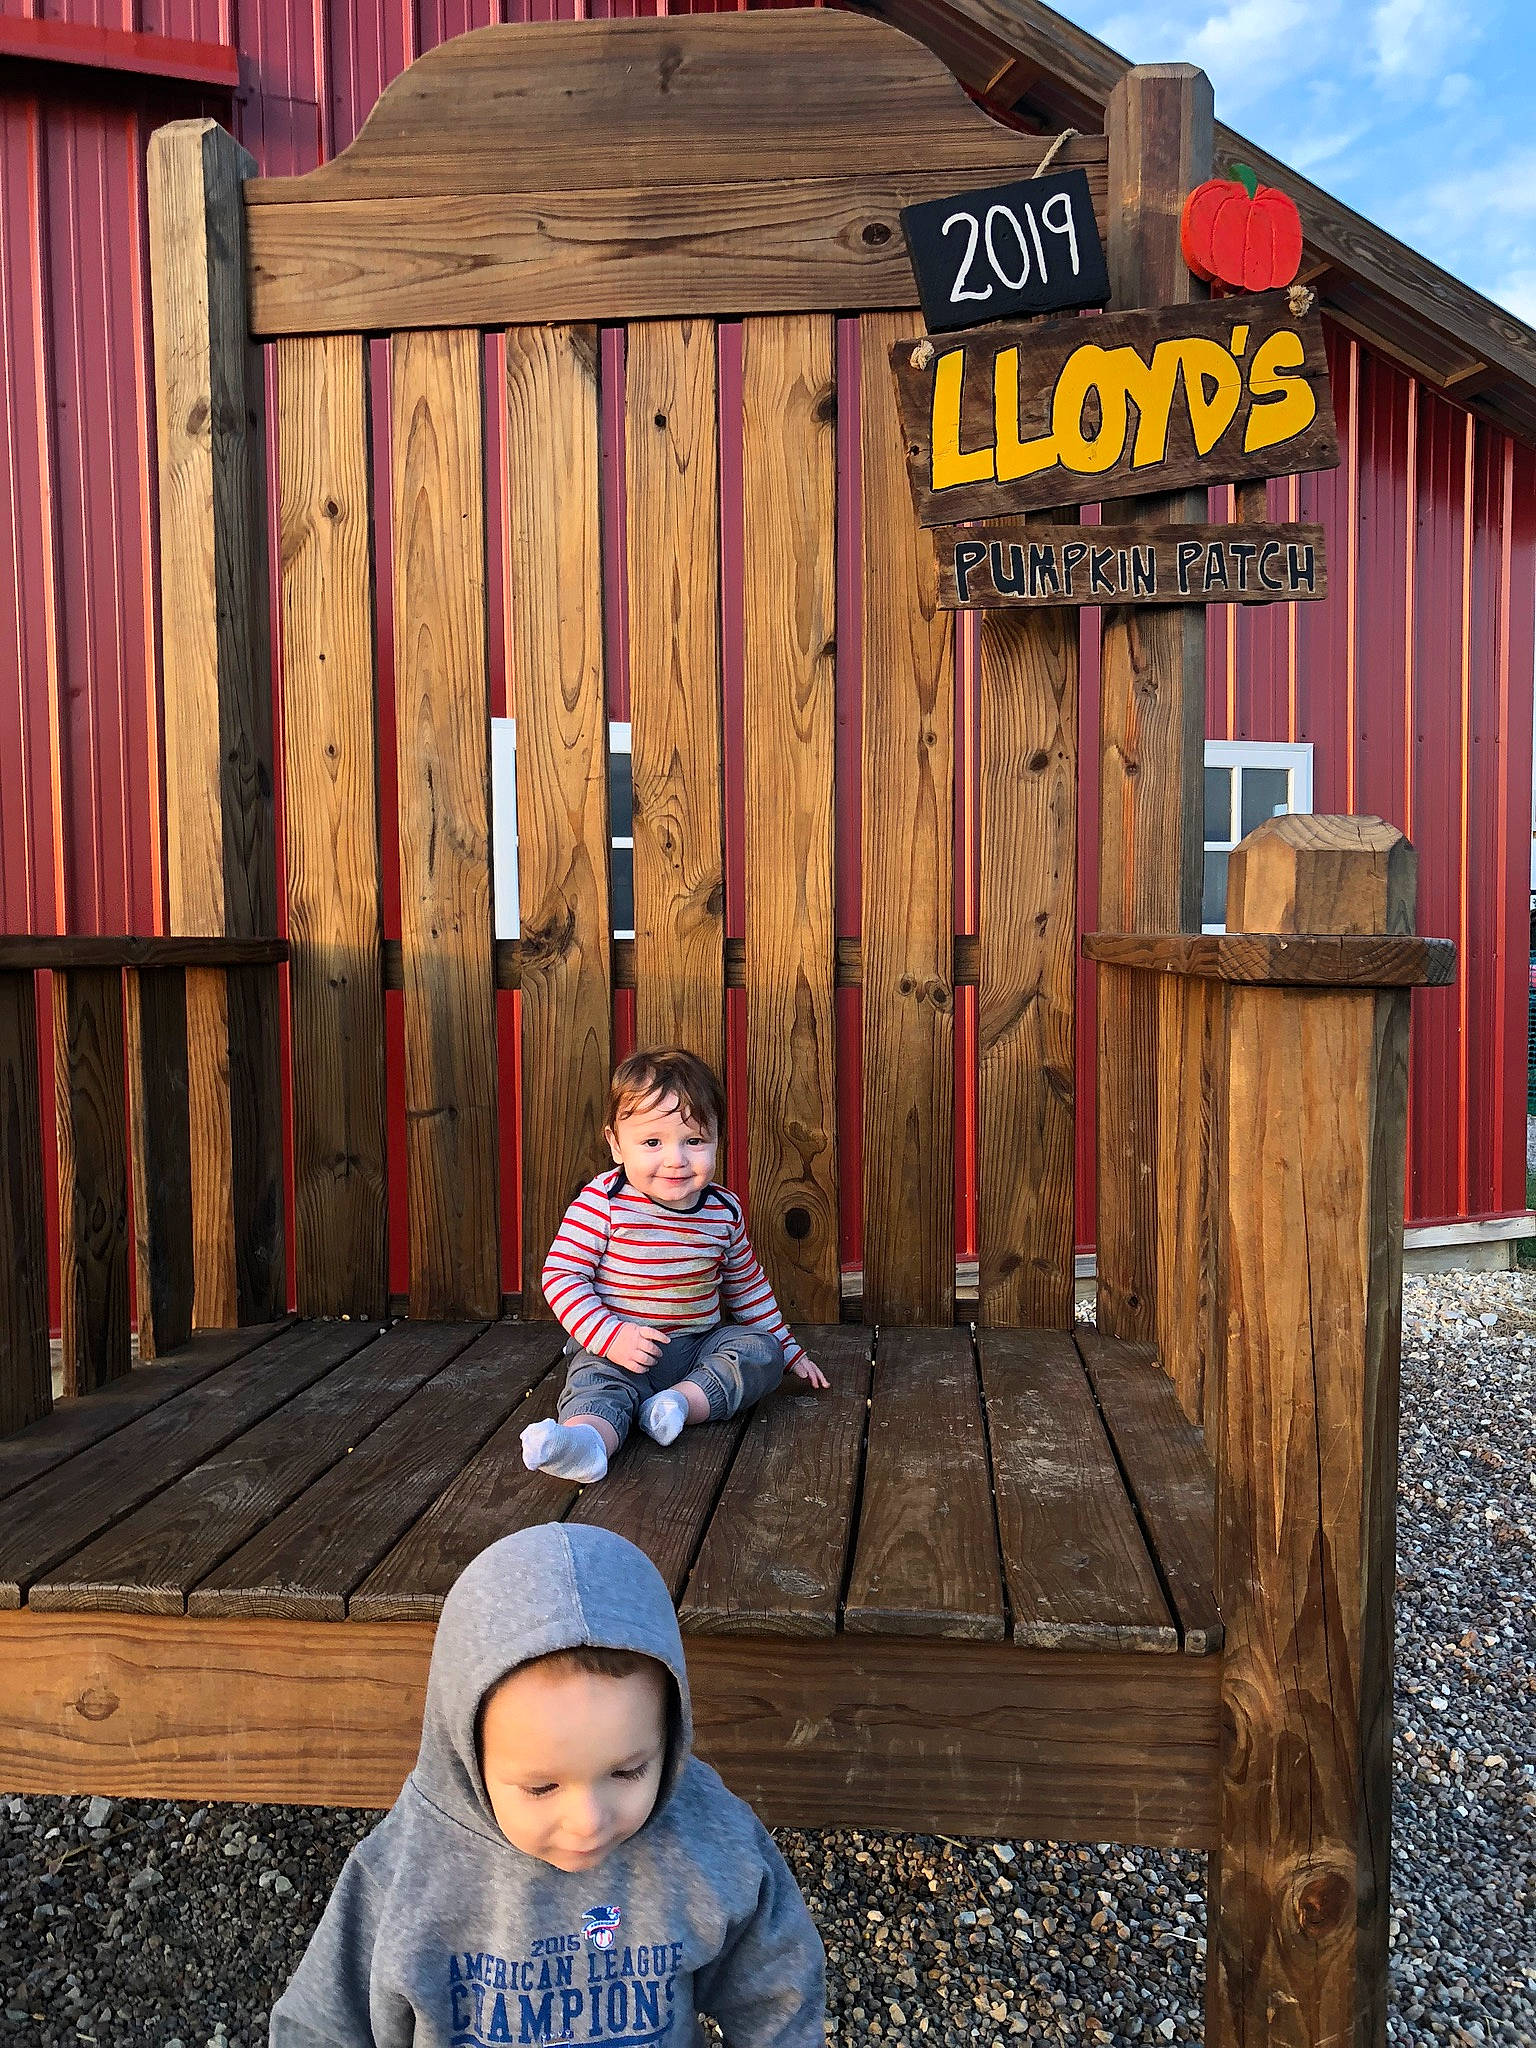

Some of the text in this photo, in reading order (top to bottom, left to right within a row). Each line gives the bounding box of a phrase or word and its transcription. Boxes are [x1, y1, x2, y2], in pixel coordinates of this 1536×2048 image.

[942, 193, 1079, 302] 2019
[930, 325, 1316, 492] LLOYD'S
[954, 541, 1314, 603] PUMPKIN PATCH
[450, 1942, 683, 1991] AMERICAN LEAGUE
[531, 1934, 581, 1957] 2015
